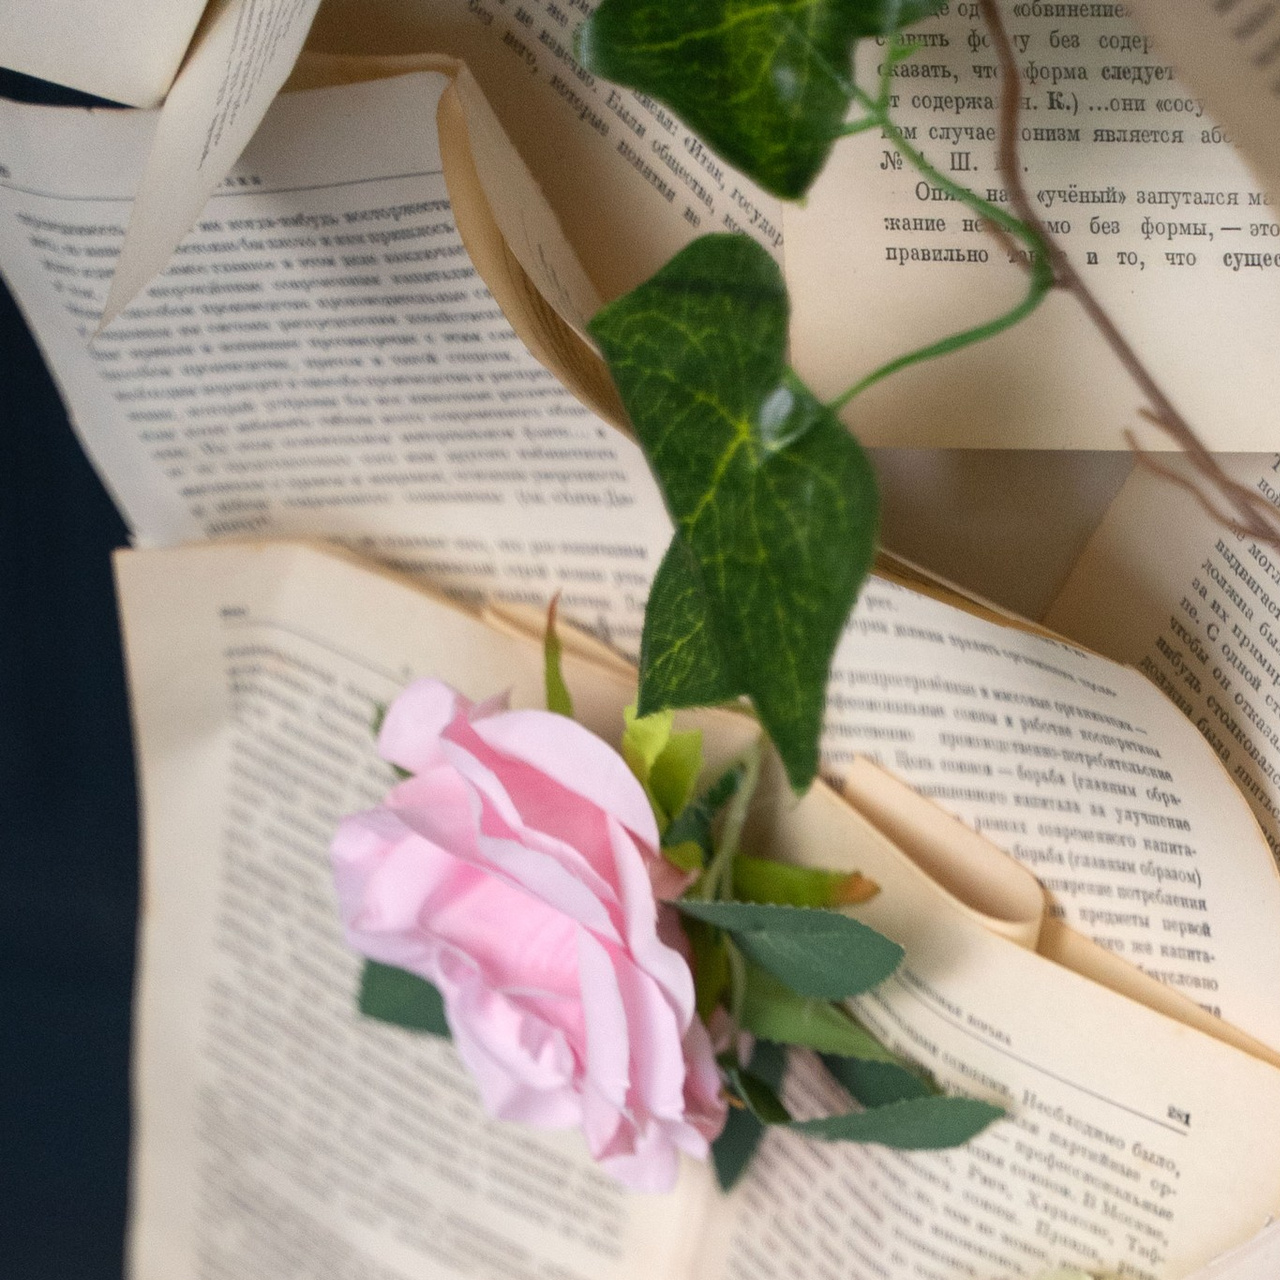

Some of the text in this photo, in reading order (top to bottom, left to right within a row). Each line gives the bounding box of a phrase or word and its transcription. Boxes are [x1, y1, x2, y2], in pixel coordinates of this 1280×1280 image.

[1049, 29, 1080, 49] без
[929, 126, 1184, 145] случае является
[880, 150, 978, 171] № Ш.
[1036, 186, 1239, 210] «учёный» запутался
[1089, 216, 1120, 235] без
[1141, 216, 1214, 241] формы,
[1250, 223, 1280, 237] это
[885, 247, 1197, 271] правильно и то, что
[1201, 558, 1254, 622] должна
[1221, 643, 1262, 692] одной
